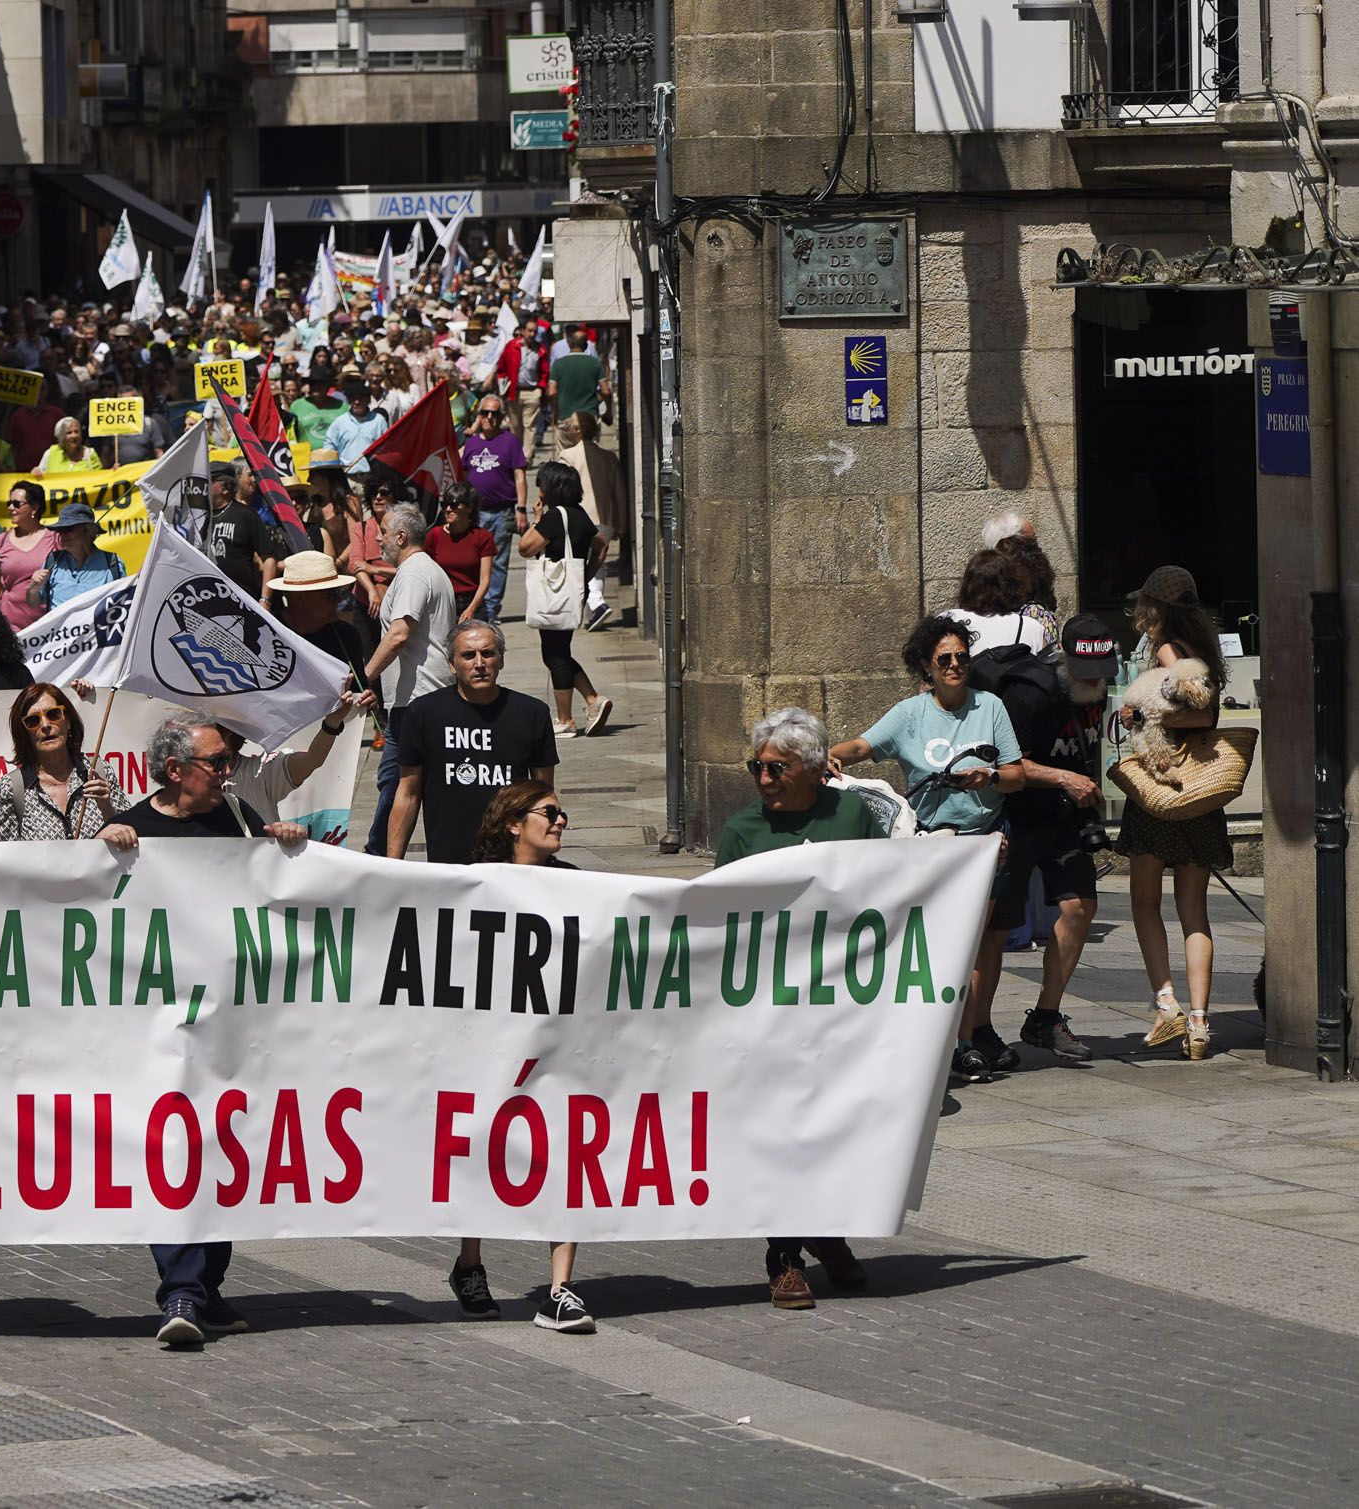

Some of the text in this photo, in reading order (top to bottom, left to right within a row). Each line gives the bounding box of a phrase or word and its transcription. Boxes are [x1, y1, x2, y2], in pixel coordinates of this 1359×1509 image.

[818, 235, 867, 249] PASEO
[829, 255, 852, 268] DE
[806, 272, 879, 287] ANTONIO
[794, 289, 889, 306] ODRIOZOLA
[201, 364, 238, 376] ENCE
[202, 377, 239, 389] FRA
[1277, 373, 1296, 386] PRAZA
[96, 401, 136, 413] ENCE
[96, 413, 136, 425] FÓRA
[170, 583, 216, 613] Pola
[33, 637, 92, 664] acción
[1075, 640, 1113, 653] NEW MOON
[445, 726, 492, 751] ENCE
[445, 757, 512, 786] FÓRA!
[60, 874, 207, 1025] RÍA,
[233, 906, 356, 1005] NIN
[379, 906, 581, 1015] ALTRI
[606, 914, 692, 1012] NA
[431, 1058, 709, 1209] FÓRA!
